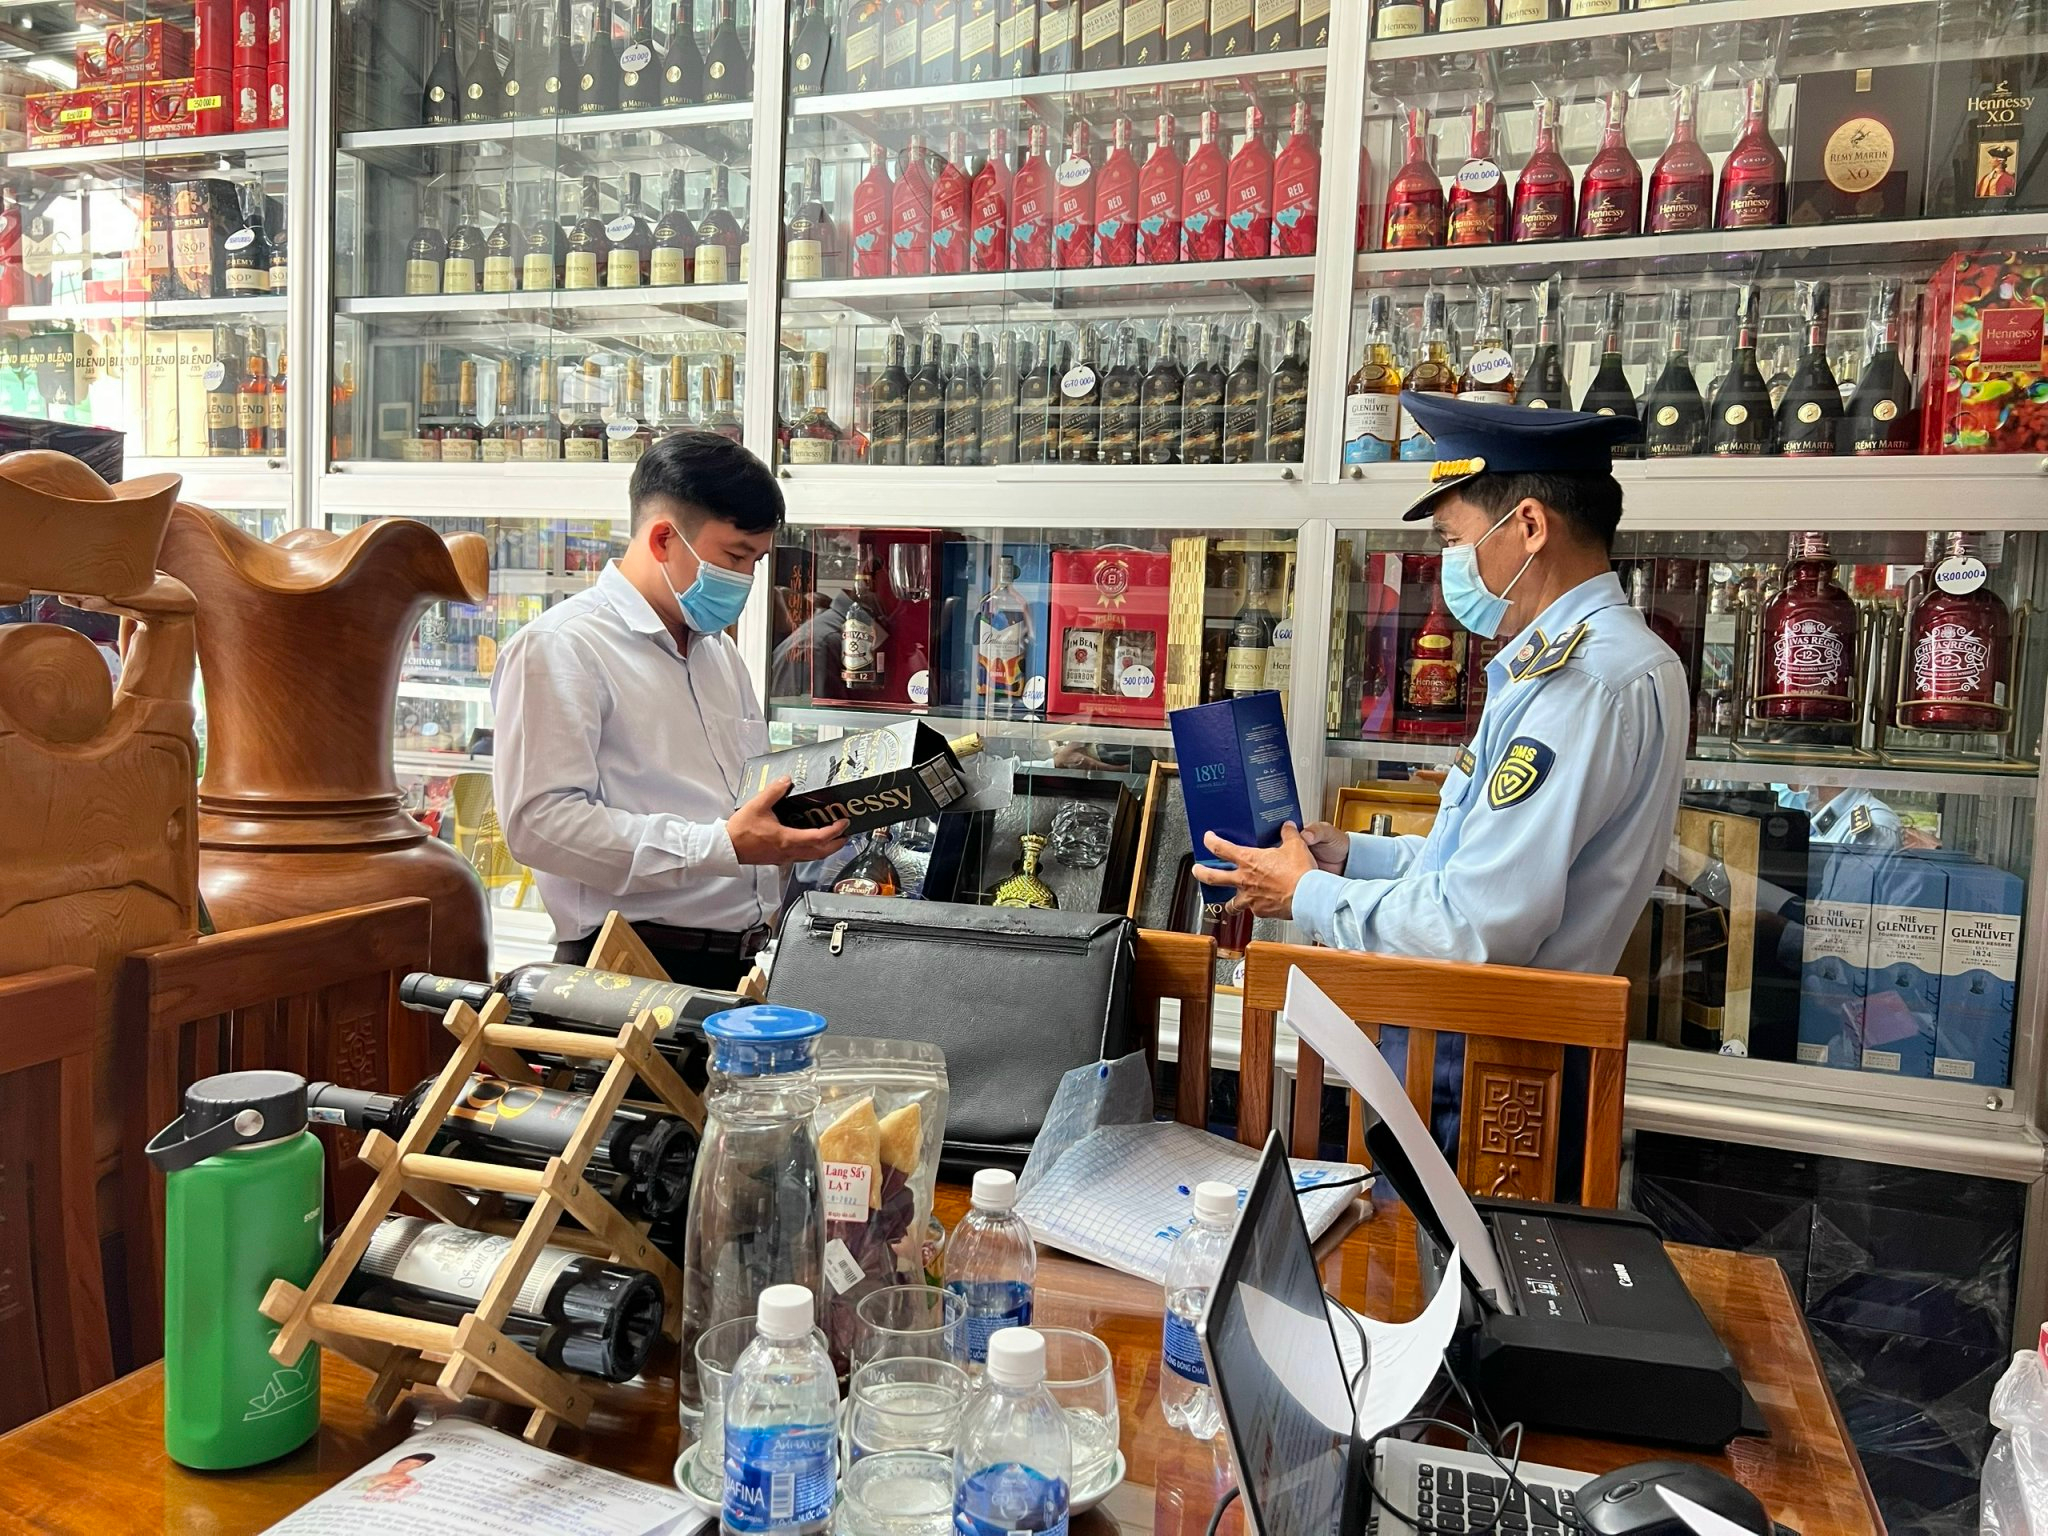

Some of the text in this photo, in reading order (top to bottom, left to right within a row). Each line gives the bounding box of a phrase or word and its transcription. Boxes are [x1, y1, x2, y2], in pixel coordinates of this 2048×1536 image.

[1506, 7, 1540, 21] Hennessy
[1446, 15, 1481, 27] Hennessy
[1384, 22, 1419, 33] Hennessy
[1967, 96, 2035, 111] Hennessy
[1854, 150, 1888, 160] MARTIN
[1847, 168, 1870, 180] XO
[1195, 189, 1210, 203] RED
[1241, 185, 1256, 200] RED
[1288, 183, 1304, 198] RED
[1107, 196, 1122, 210] RED
[1151, 191, 1167, 207] RED
[1731, 199, 1771, 209] Hennessy
[983, 203, 997, 218] RED
[1022, 200, 1037, 214] RED
[1064, 198, 1078, 213] RED
[1659, 203, 1698, 214] Hennessy
[864, 211, 877, 224] RED
[903, 208, 916, 221] RED
[941, 206, 954, 221] RED
[1521, 213, 1558, 223] Hennessy
[1588, 209, 1625, 219] Hennessy
[1987, 329, 2038, 340] Hennessy
[21, 354, 45, 363] BLEND
[48, 353, 72, 362] BLEND
[76, 358, 105, 368] BLEND
[145, 355, 175, 366] BLEND
[180, 355, 212, 365] BLEND
[208, 405, 233, 414] LEND
[239, 405, 264, 414] LEND
[1352, 405, 1389, 413] GLENLIVET
[1663, 444, 1692, 452] MARTIN
[1730, 442, 1761, 451] MARTIN
[1802, 441, 1834, 450] MARTIN
[1879, 440, 1910, 449] MARTIN
[842, 631, 869, 640] CHIVAS
[1066, 637, 1098, 651] JIM BEAM
[1776, 636, 1841, 651] CHIVAS REGAL
[1916, 641, 1984, 656] CHIVAS REGAL
[1802, 651, 1812, 659] 12
[1940, 656, 1950, 665] 12
[1230, 662, 1261, 670] Hennessy
[1273, 662, 1291, 670] Henn
[1066, 672, 1094, 680] BOURBON
[1472, 640, 1498, 706] Henn
[1510, 745, 1537, 762] DMS
[790, 785, 912, 828] ennessy
[1205, 903, 1222, 917] XO
[1827, 909, 1844, 917] THE
[1806, 915, 1864, 930] GLENLIVET
[1899, 915, 1917, 923] THE
[1877, 921, 1938, 935] GLENLIVET
[1975, 922, 1993, 930] THE
[1952, 927, 2015, 942] GLENLIVET
[1972, 949, 1991, 957] 1824
[825, 1165, 866, 1180] Lang Sấy
[828, 1181, 852, 1192] LẠT
[725, 1477, 765, 1508] UAFINA
